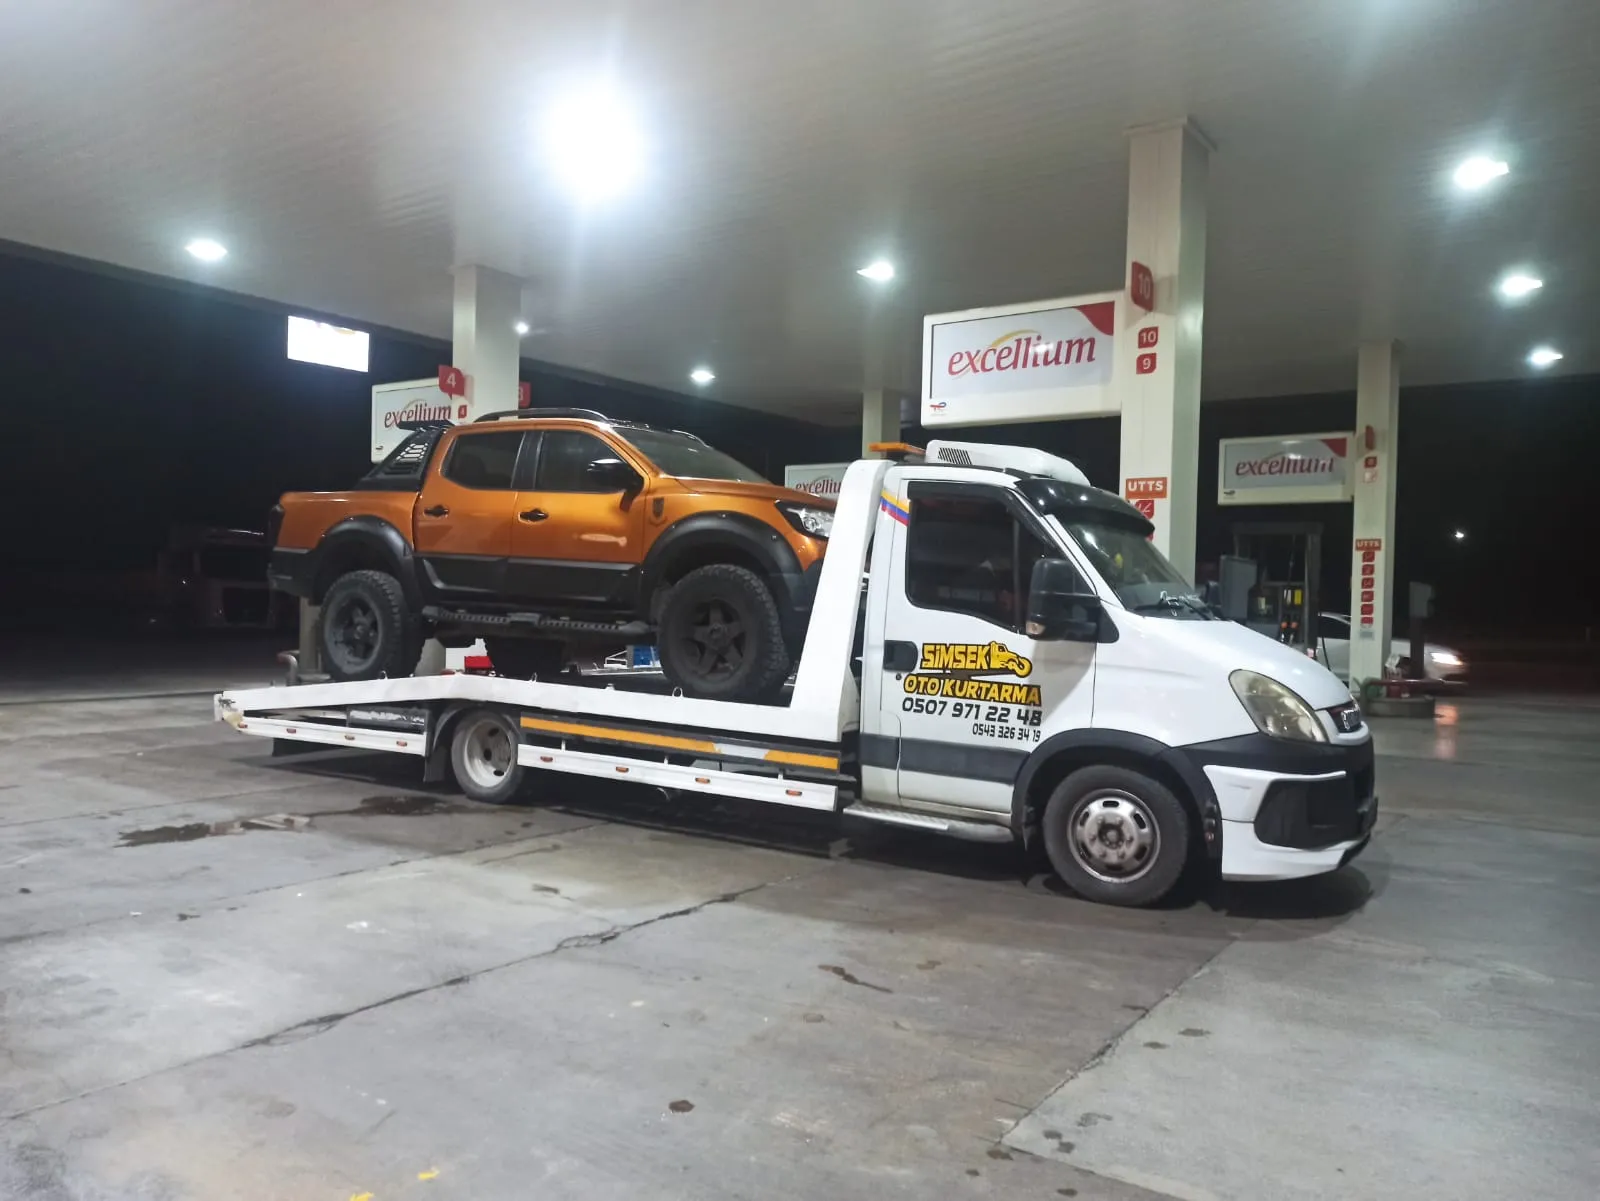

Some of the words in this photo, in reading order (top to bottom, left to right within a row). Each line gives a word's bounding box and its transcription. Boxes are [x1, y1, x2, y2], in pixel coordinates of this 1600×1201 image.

[1142, 331, 1157, 345] 10
[947, 334, 1097, 376] excellium
[1143, 358, 1151, 370] 9
[446, 373, 457, 388] 4
[384, 402, 452, 428] excellium
[1235, 456, 1334, 477] excellium
[795, 479, 841, 494] excelliu
[1128, 480, 1164, 492] UTTS
[904, 673, 941, 696] OTO
[941, 679, 1041, 706] KURTARMA
[902, 697, 947, 716] 0507
[952, 702, 981, 720] 971
[985, 706, 1011, 723] 22
[1016, 708, 1043, 726] 48
[972, 723, 996, 738] 0543
[997, 726, 1015, 740] 326
[1017, 729, 1030, 741] 34
